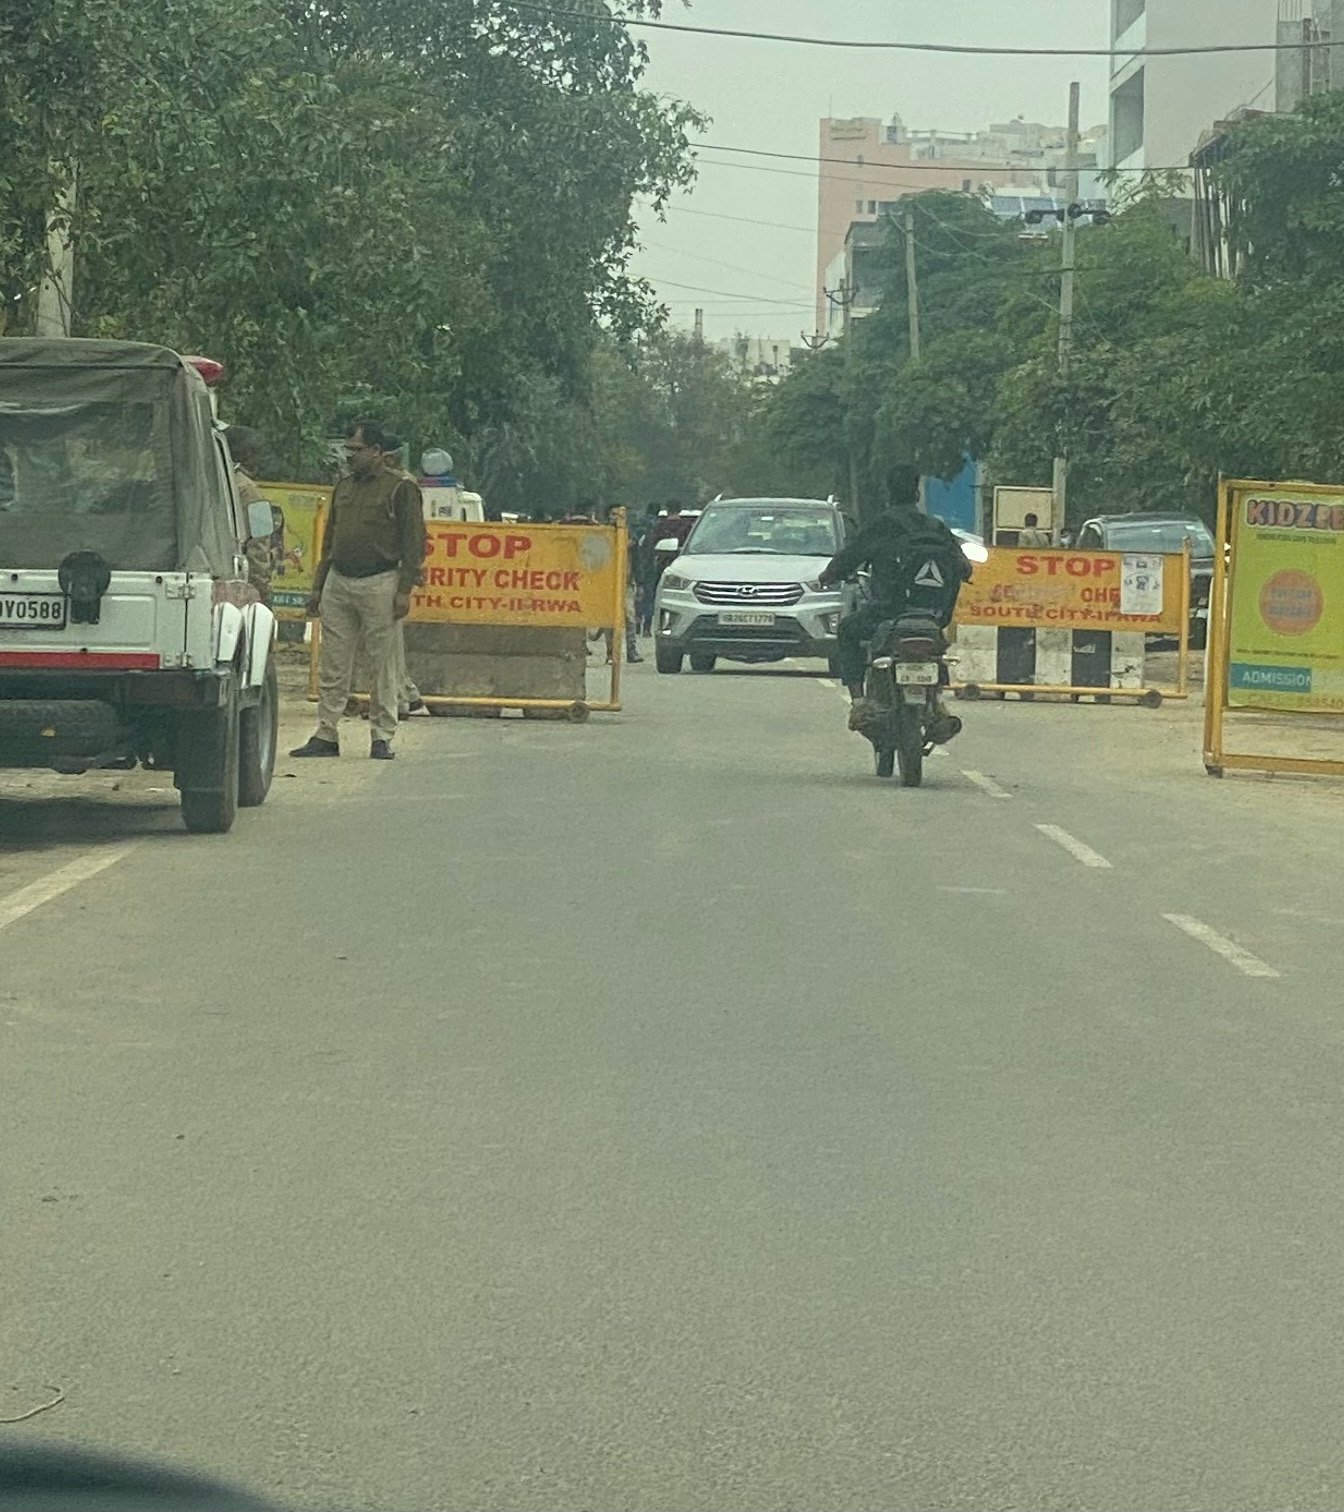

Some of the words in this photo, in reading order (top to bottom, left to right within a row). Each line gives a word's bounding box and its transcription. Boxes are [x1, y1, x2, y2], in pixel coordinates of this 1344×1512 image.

[1016, 555, 1115, 578] STOP
[422, 567, 488, 587] RITY
[494, 569, 580, 591] CHECK
[1080, 587, 1120, 603] CHE
